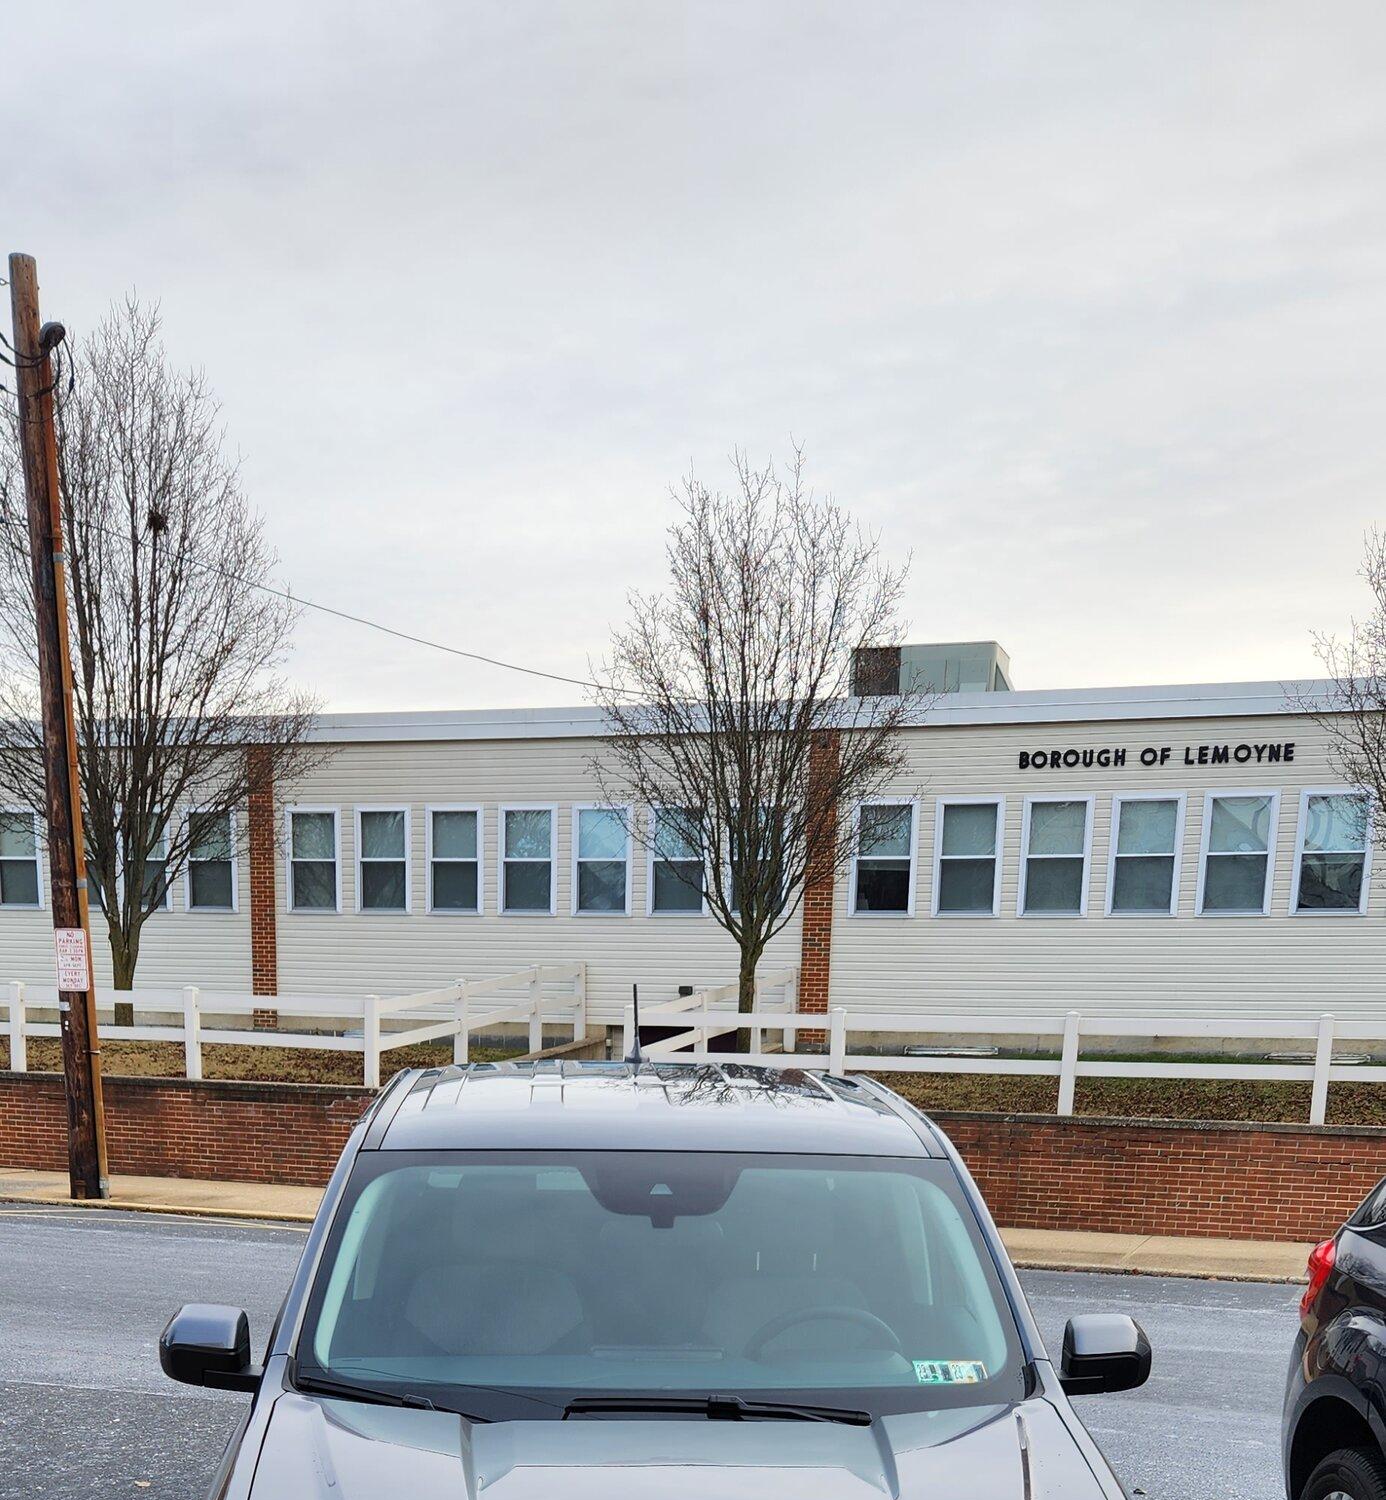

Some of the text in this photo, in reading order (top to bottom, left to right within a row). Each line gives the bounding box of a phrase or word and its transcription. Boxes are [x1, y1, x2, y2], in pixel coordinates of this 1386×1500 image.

[1018, 742, 1296, 769] BOROUGH OF LEMOYNE
